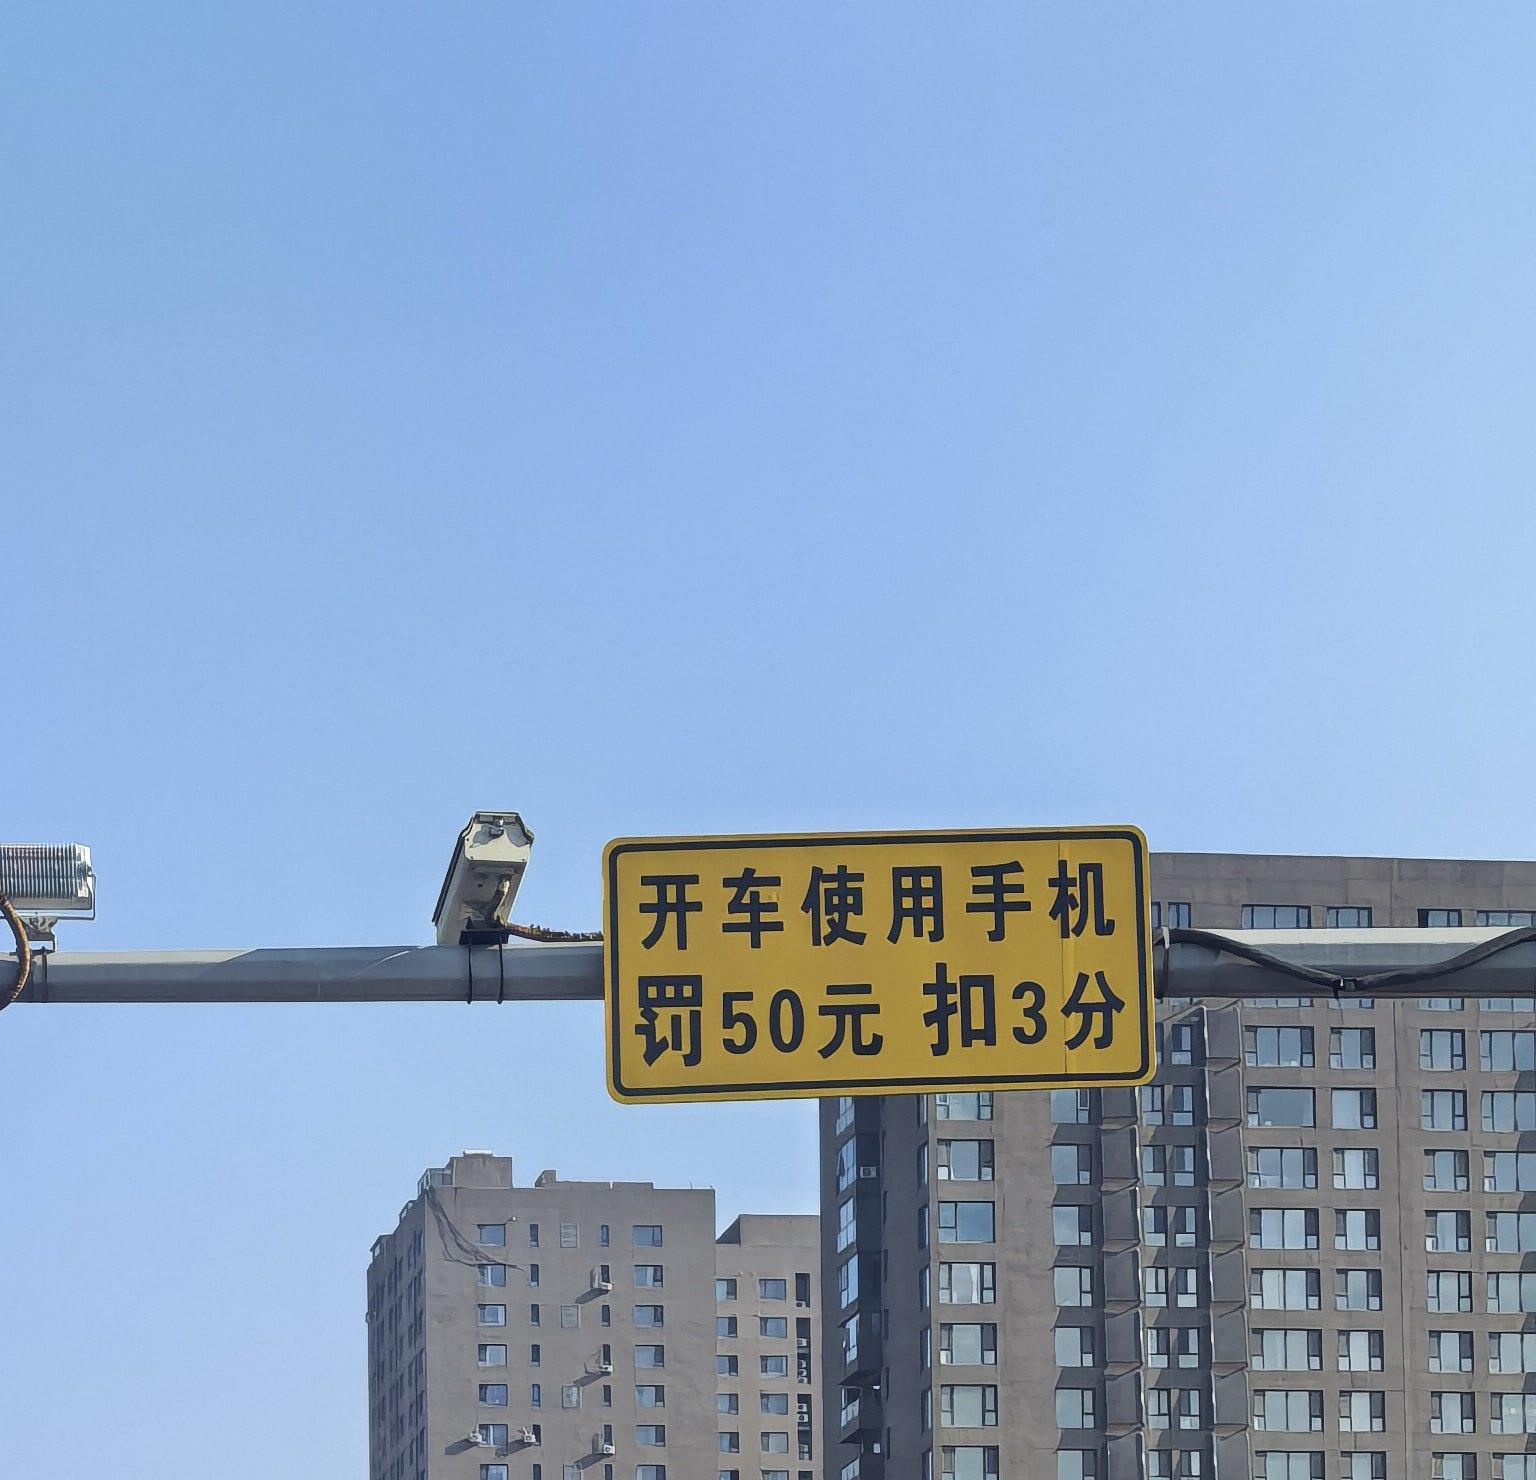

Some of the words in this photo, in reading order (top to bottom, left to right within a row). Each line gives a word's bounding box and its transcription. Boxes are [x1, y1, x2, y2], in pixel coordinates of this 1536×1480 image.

[638, 859, 1116, 951] 开车使用手机
[634, 974, 884, 1068] 罚50元
[922, 962, 1126, 1057] 扣3分
